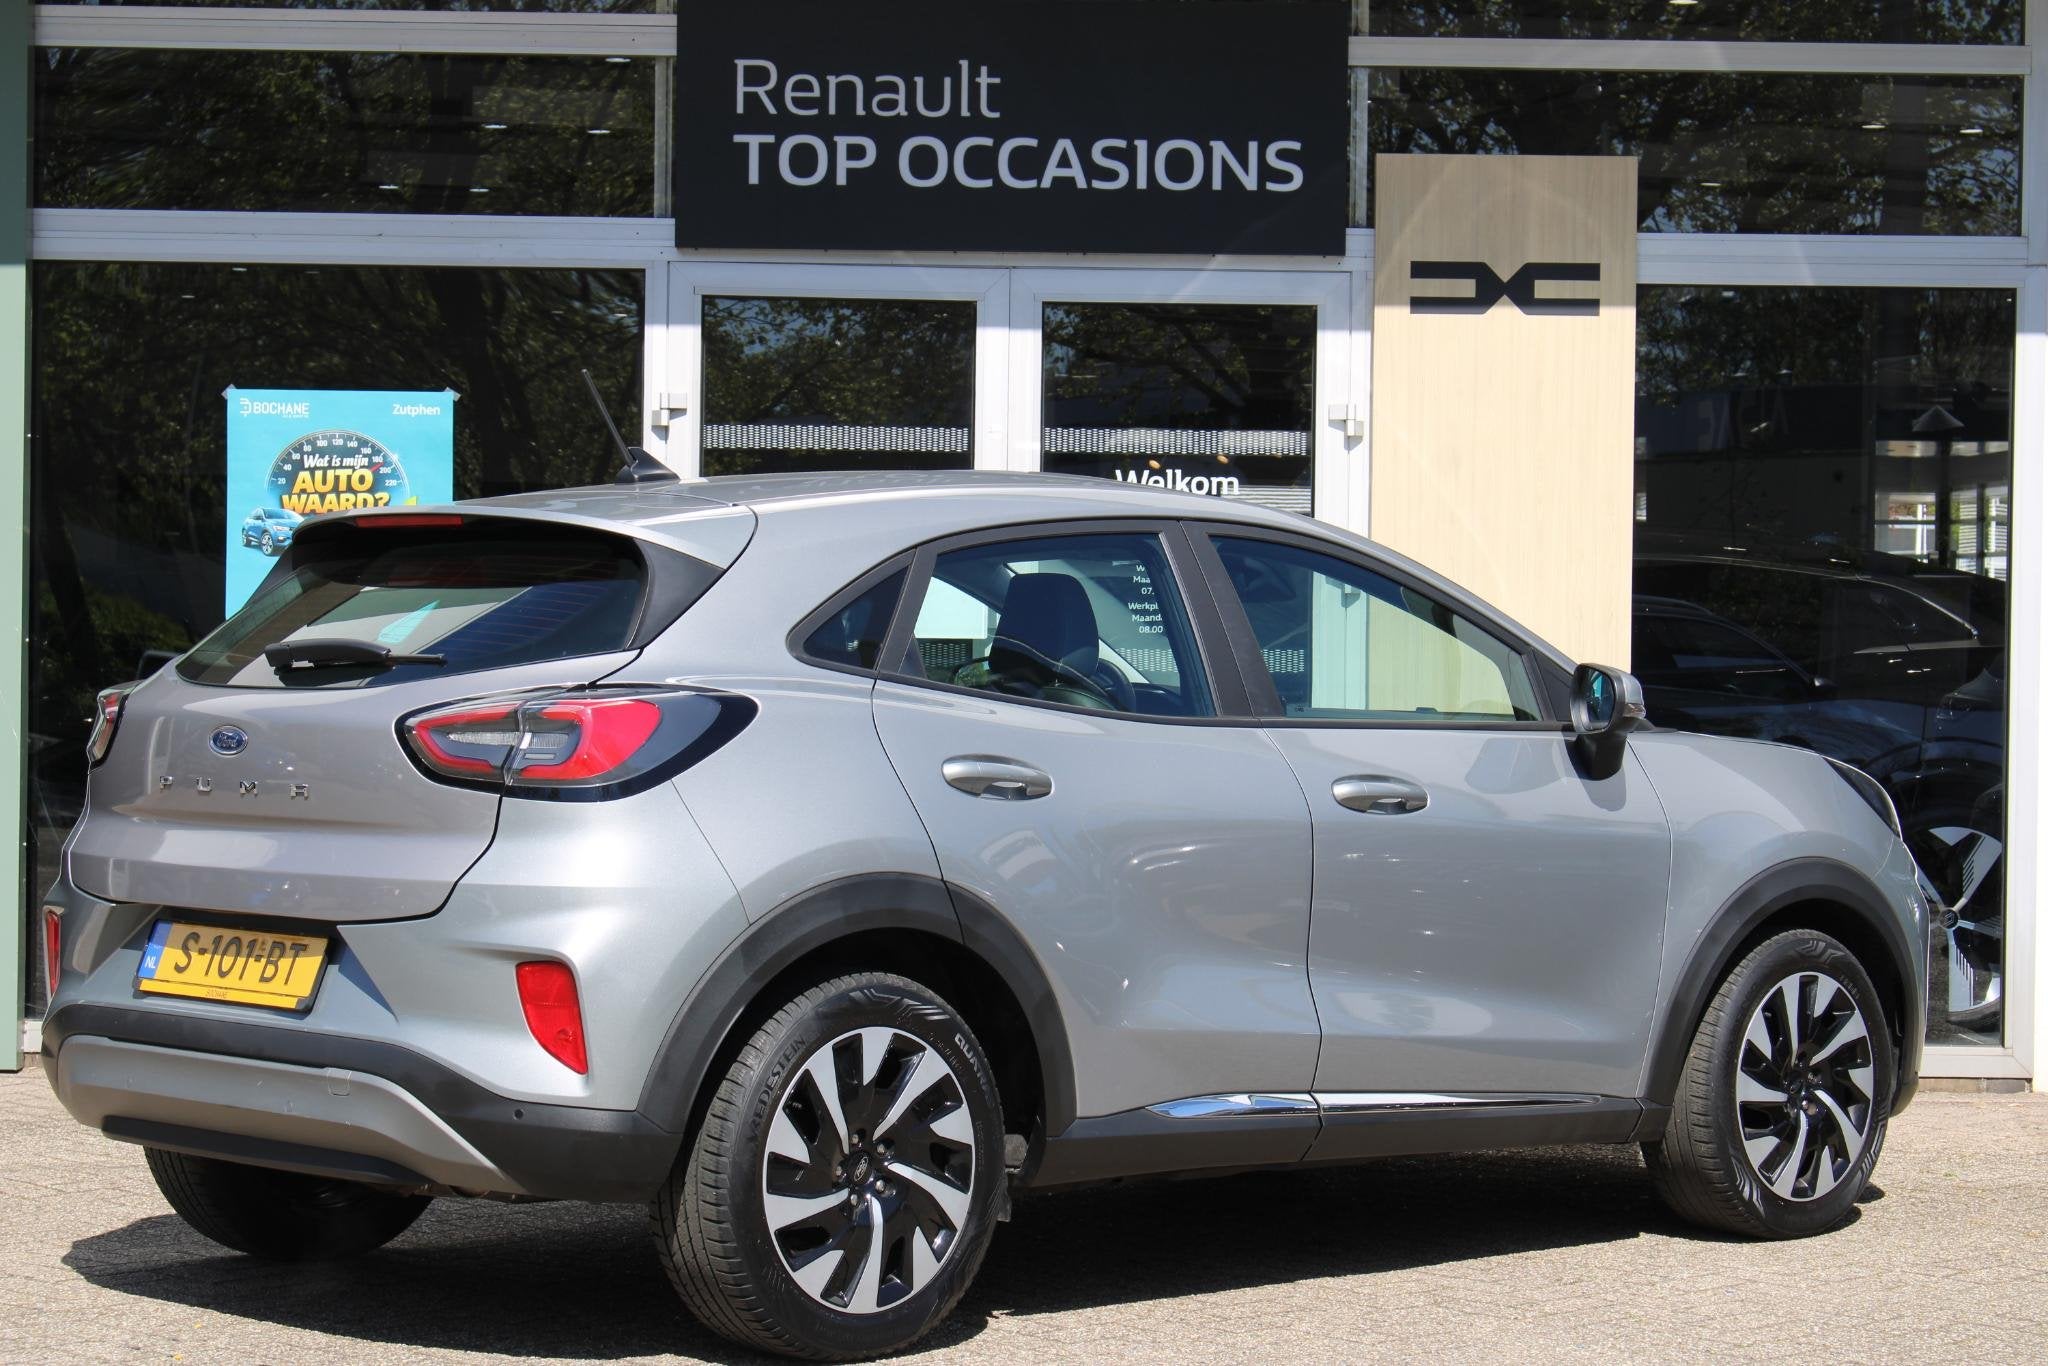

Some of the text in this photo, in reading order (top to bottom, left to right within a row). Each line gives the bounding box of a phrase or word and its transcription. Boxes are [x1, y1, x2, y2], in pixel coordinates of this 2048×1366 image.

[734, 59, 1001, 118] Renault
[733, 134, 1304, 193] TOP OCCASIONS
[252, 402, 310, 415] BOCHANE
[392, 403, 441, 418] Zutphen
[346, 440, 358, 448] 140
[282, 463, 292, 471] 40
[303, 453, 369, 469] Wat is mijn
[379, 466, 391, 474] 200
[291, 468, 374, 494] AUTO
[1115, 468, 1240, 496] Welkom
[281, 491, 390, 514] WAARD?
[1131, 613, 1163, 622] Maand
[1139, 625, 1163, 633] 08.00
[159, 775, 309, 800] PUMA
[144, 955, 157, 969] NL
[174, 931, 309, 985] S-101-BT
